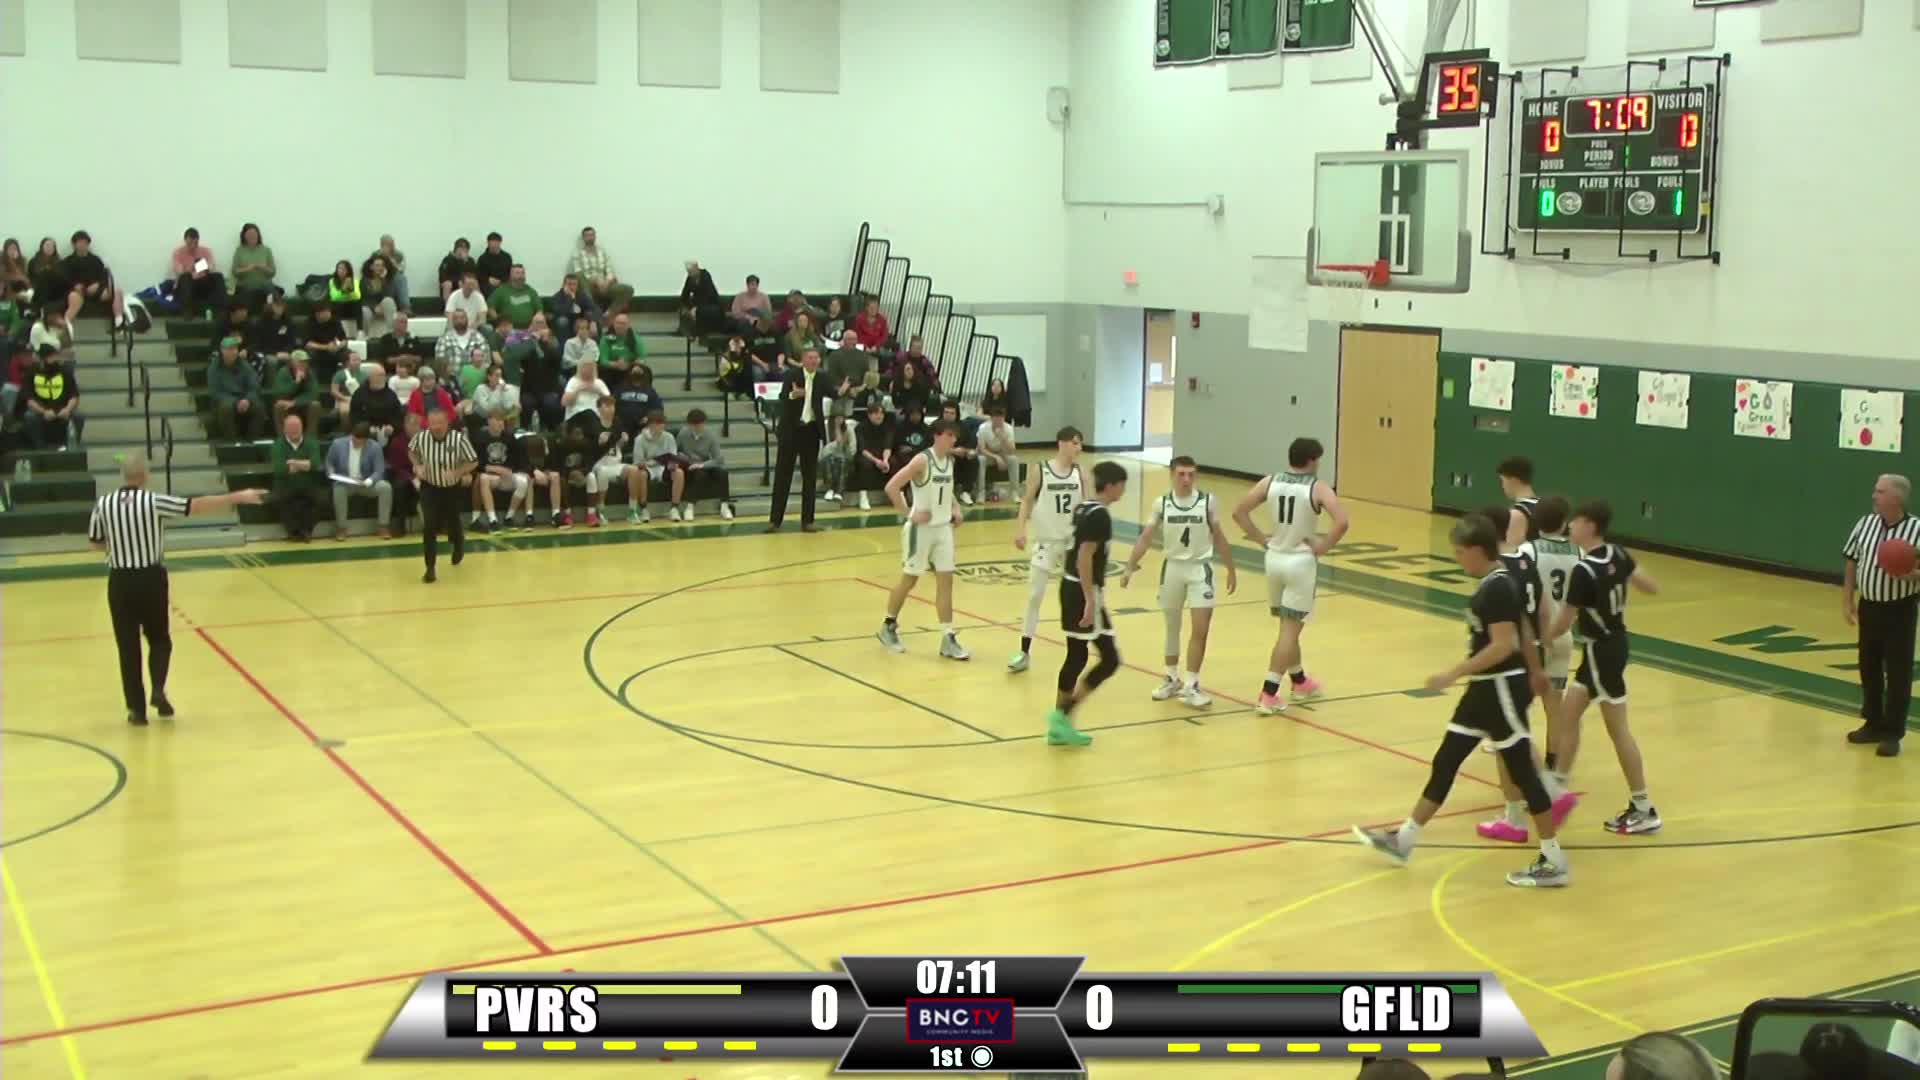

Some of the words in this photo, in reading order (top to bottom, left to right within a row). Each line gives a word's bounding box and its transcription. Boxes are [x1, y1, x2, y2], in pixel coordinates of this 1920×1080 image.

[1440, 66, 1480, 111] 35
[1528, 101, 1559, 117] HOME
[1657, 91, 1703, 110] VISITOR
[1587, 98, 1648, 131] 7:09
[1544, 121, 1561, 152] 0
[1584, 150, 1613, 161] PERIOD
[1650, 155, 1679, 167] BONUS
[1580, 177, 1609, 189] PLAYER
[1541, 191, 1555, 217] 0
[1675, 190, 1683, 216] 1
[937, 486, 944, 506] 1
[1056, 493, 1072, 514] 12
[1278, 496, 1296, 525] 11
[1180, 527, 1190, 548] 4
[1549, 569, 1566, 602] 3
